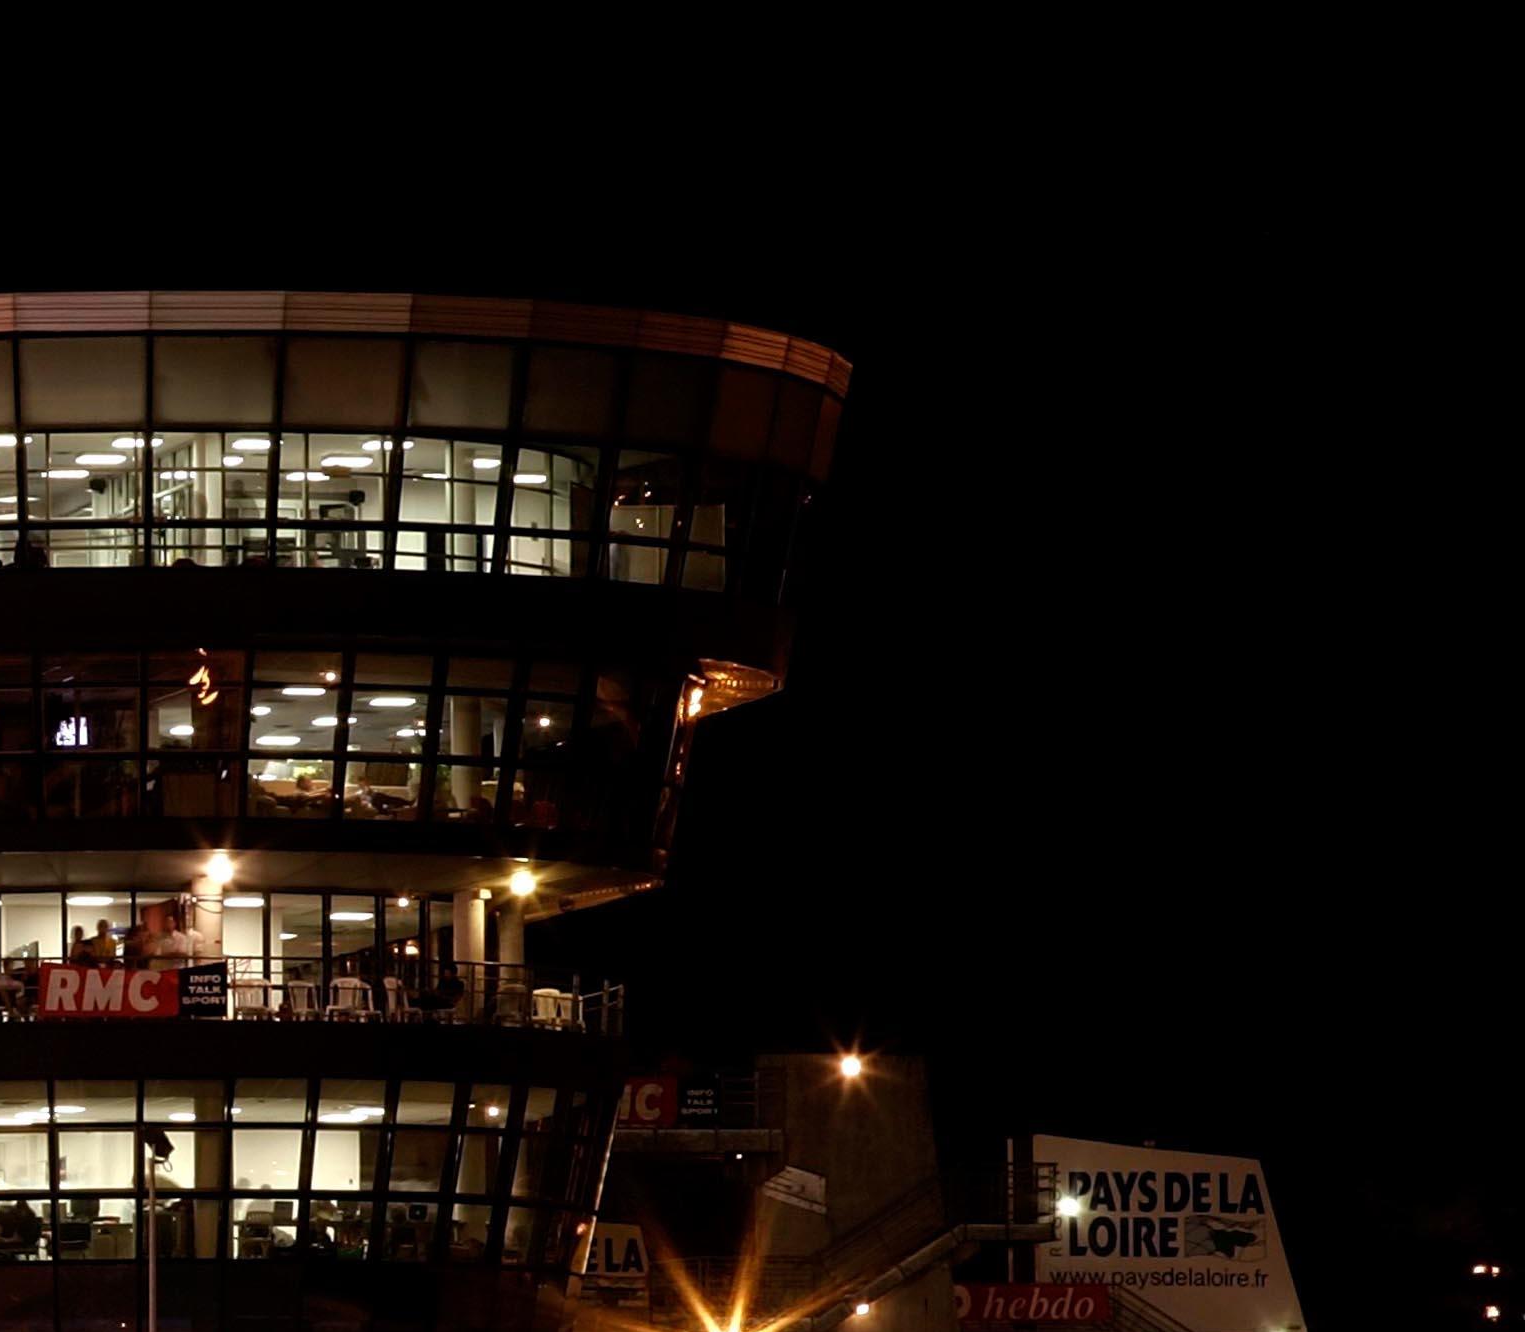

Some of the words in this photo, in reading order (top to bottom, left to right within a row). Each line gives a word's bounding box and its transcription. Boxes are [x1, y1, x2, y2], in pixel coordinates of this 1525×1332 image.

[45, 969, 161, 1012] RMC
[188, 985, 222, 994] TALK
[189, 974, 221, 984] INFO
[182, 996, 225, 1005] SPORT
[1069, 1171, 1158, 1213] PAYS
[1165, 1172, 1211, 1213] DE
[1219, 1173, 1265, 1214] LA
[1069, 1217, 1179, 1258] LOIRE
[1051, 1268, 1269, 1288] www.paysdelaloire.fr
[983, 1286, 1096, 1320] hebdo
